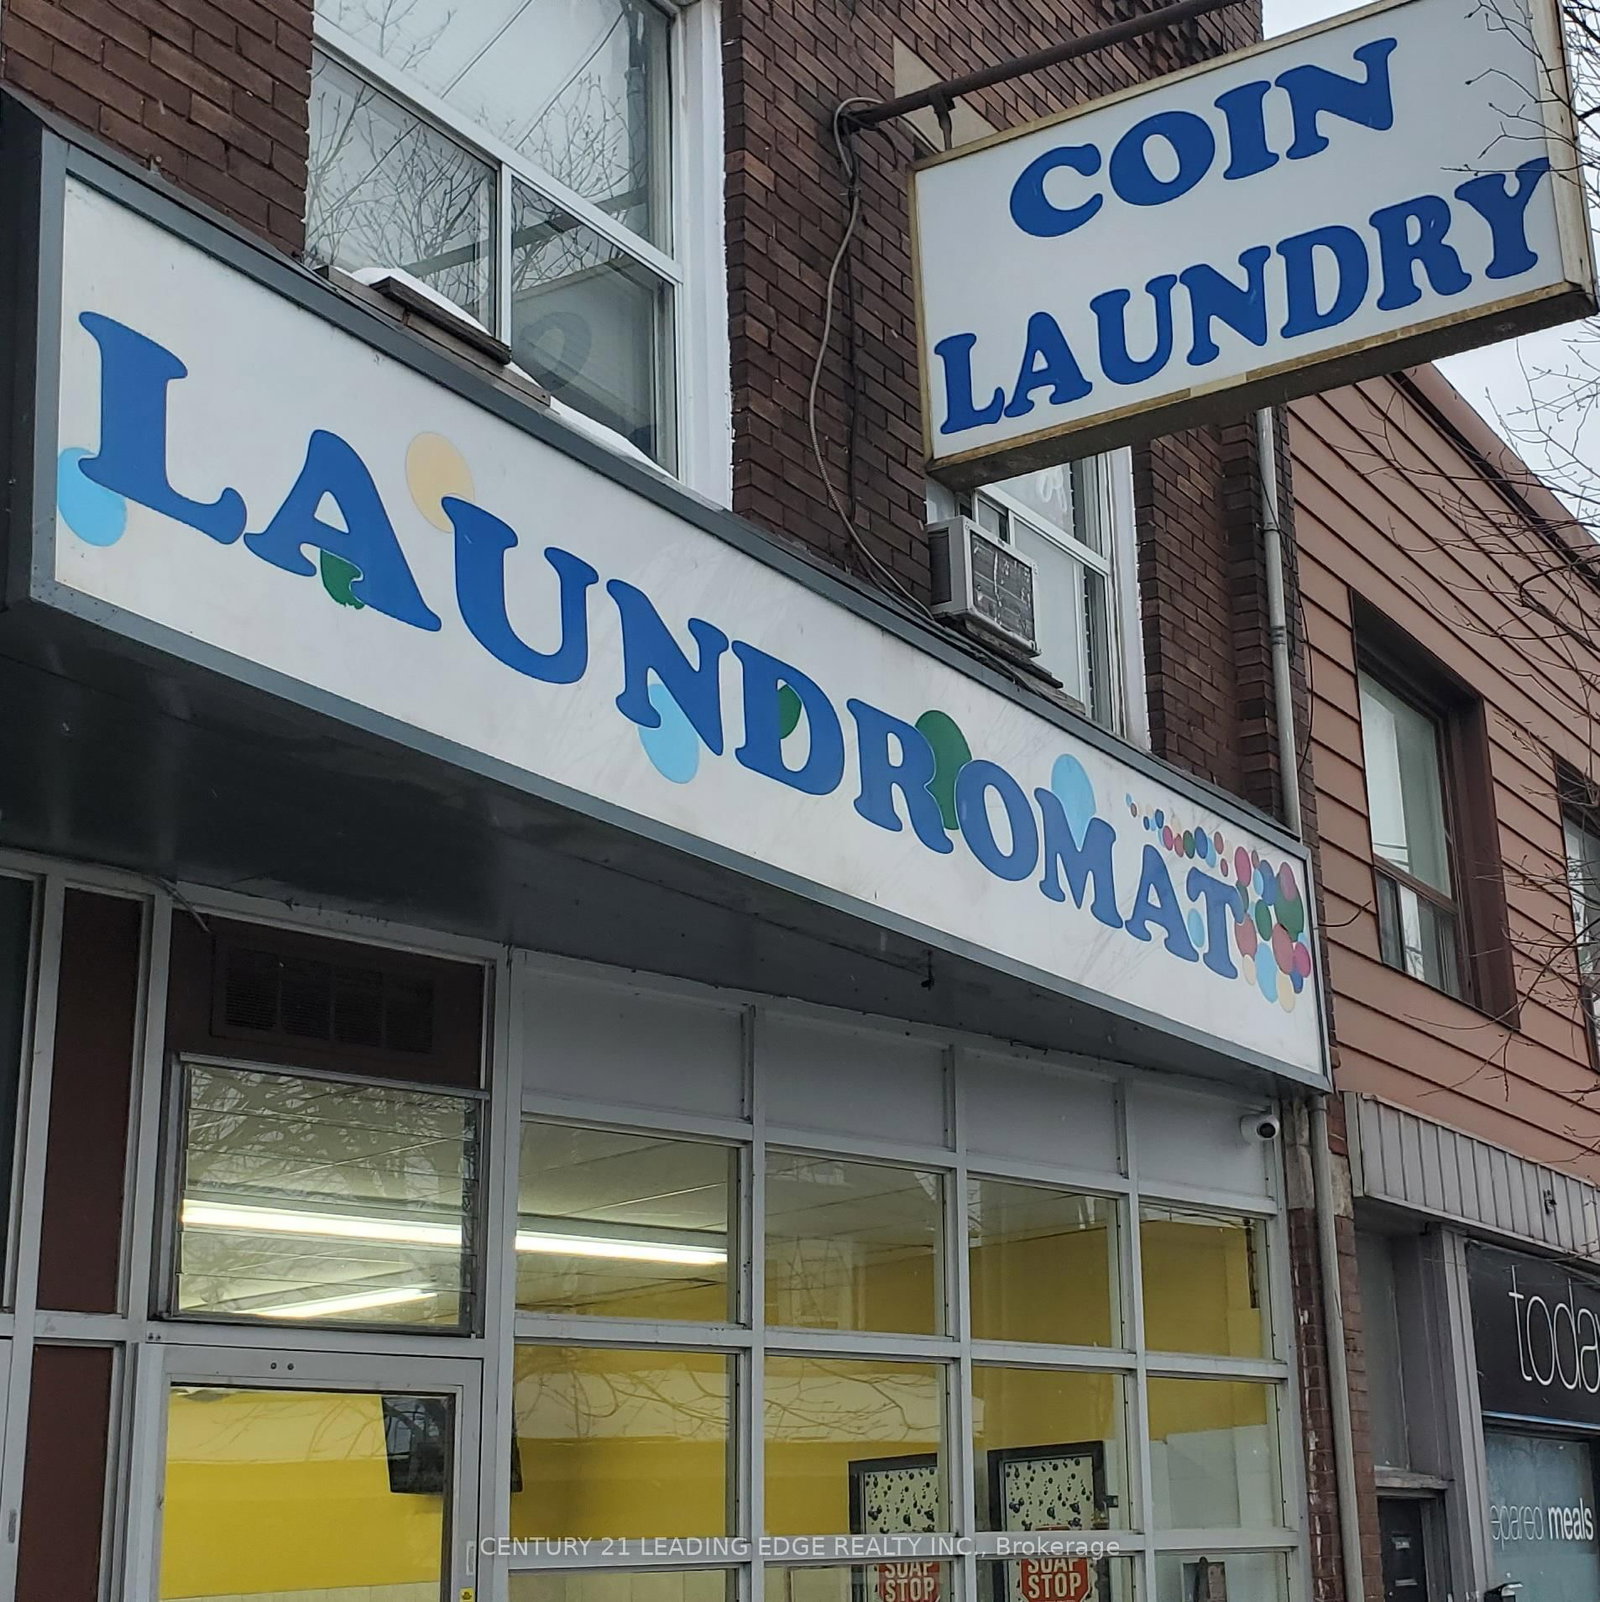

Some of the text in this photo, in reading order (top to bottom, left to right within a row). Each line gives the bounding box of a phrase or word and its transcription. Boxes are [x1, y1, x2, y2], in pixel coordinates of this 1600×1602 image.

[1010, 37, 1397, 238] COIN
[935, 157, 1550, 434] LAUNDRY
[79, 311, 1239, 980] LAUNDROMAT
[1508, 1264, 1600, 1393] toda
[1548, 1497, 1594, 1540] meals
[884, 1577, 935, 1602] STOP
[1028, 1573, 1081, 1598] STOP
